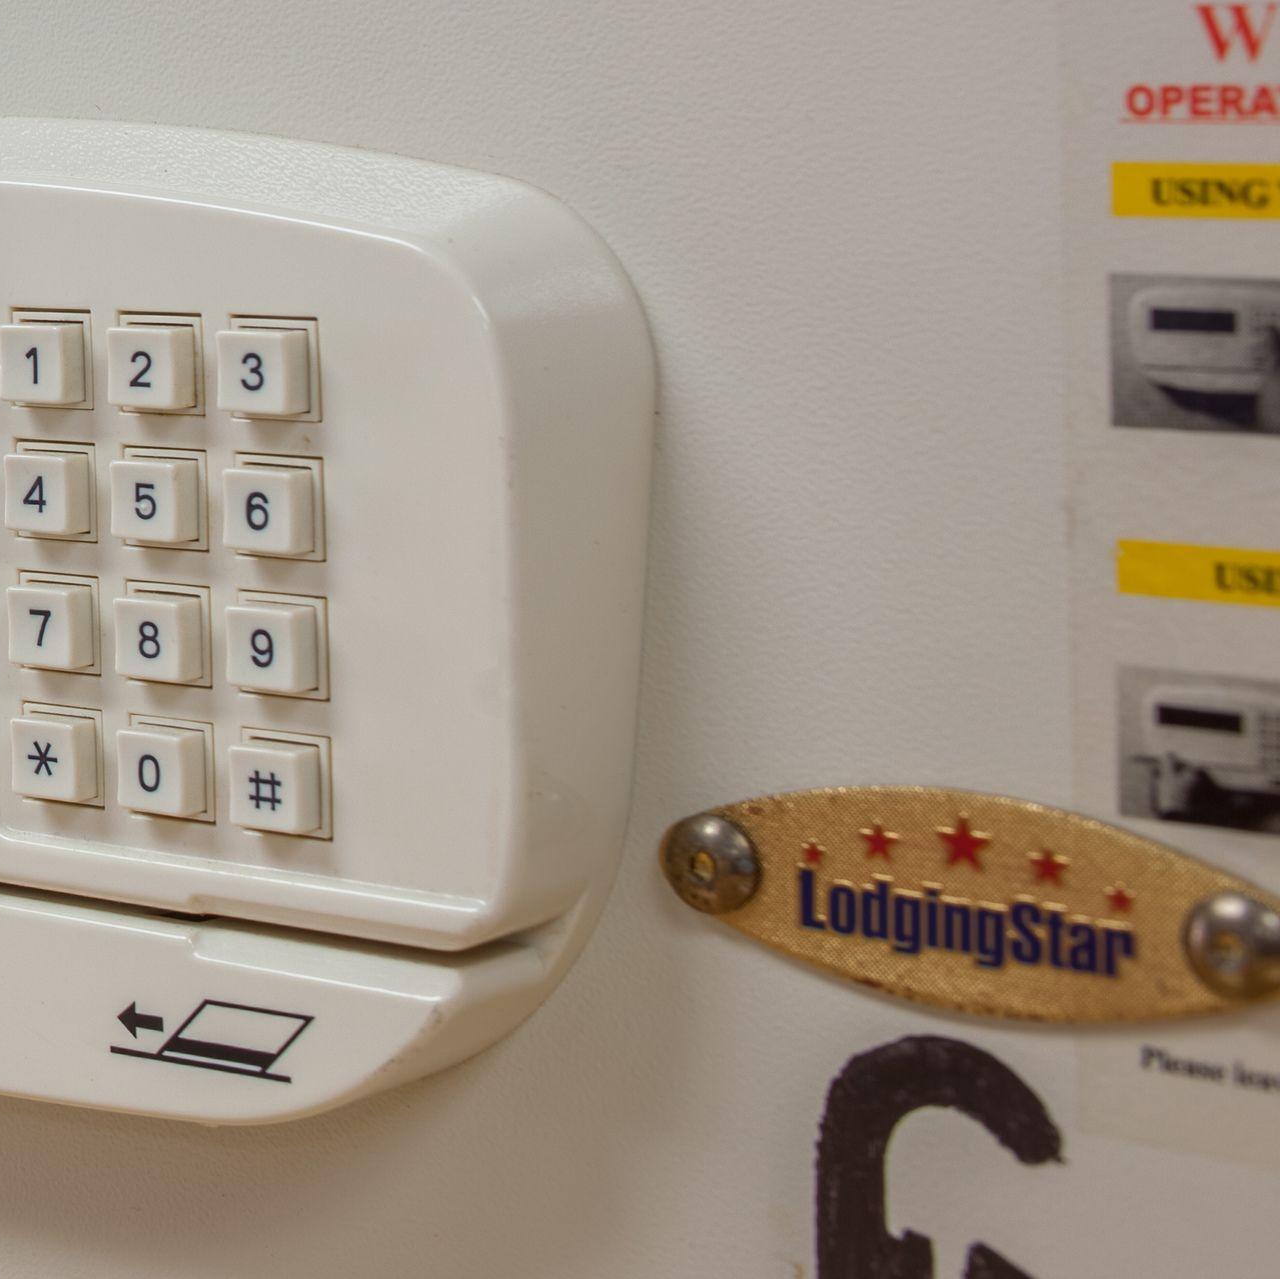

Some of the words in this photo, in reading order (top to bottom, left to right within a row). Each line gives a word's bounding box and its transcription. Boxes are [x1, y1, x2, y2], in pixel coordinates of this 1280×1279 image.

[1125, 84, 1280, 118] OPERA
[1151, 176, 1270, 210] USING
[24, 346, 39, 386] 1
[128, 350, 153, 389] 2
[239, 352, 265, 393] 3
[22, 475, 47, 514] 4
[133, 482, 157, 521] 5
[244, 491, 270, 532] 6
[27, 608, 52, 648] 7
[138, 620, 162, 660] 8
[249, 628, 275, 669] 9
[138, 753, 161, 793] 0
[247, 769, 283, 812] #
[797, 867, 1137, 979] LodgingStar
[1140, 1045, 1226, 1084] Please
